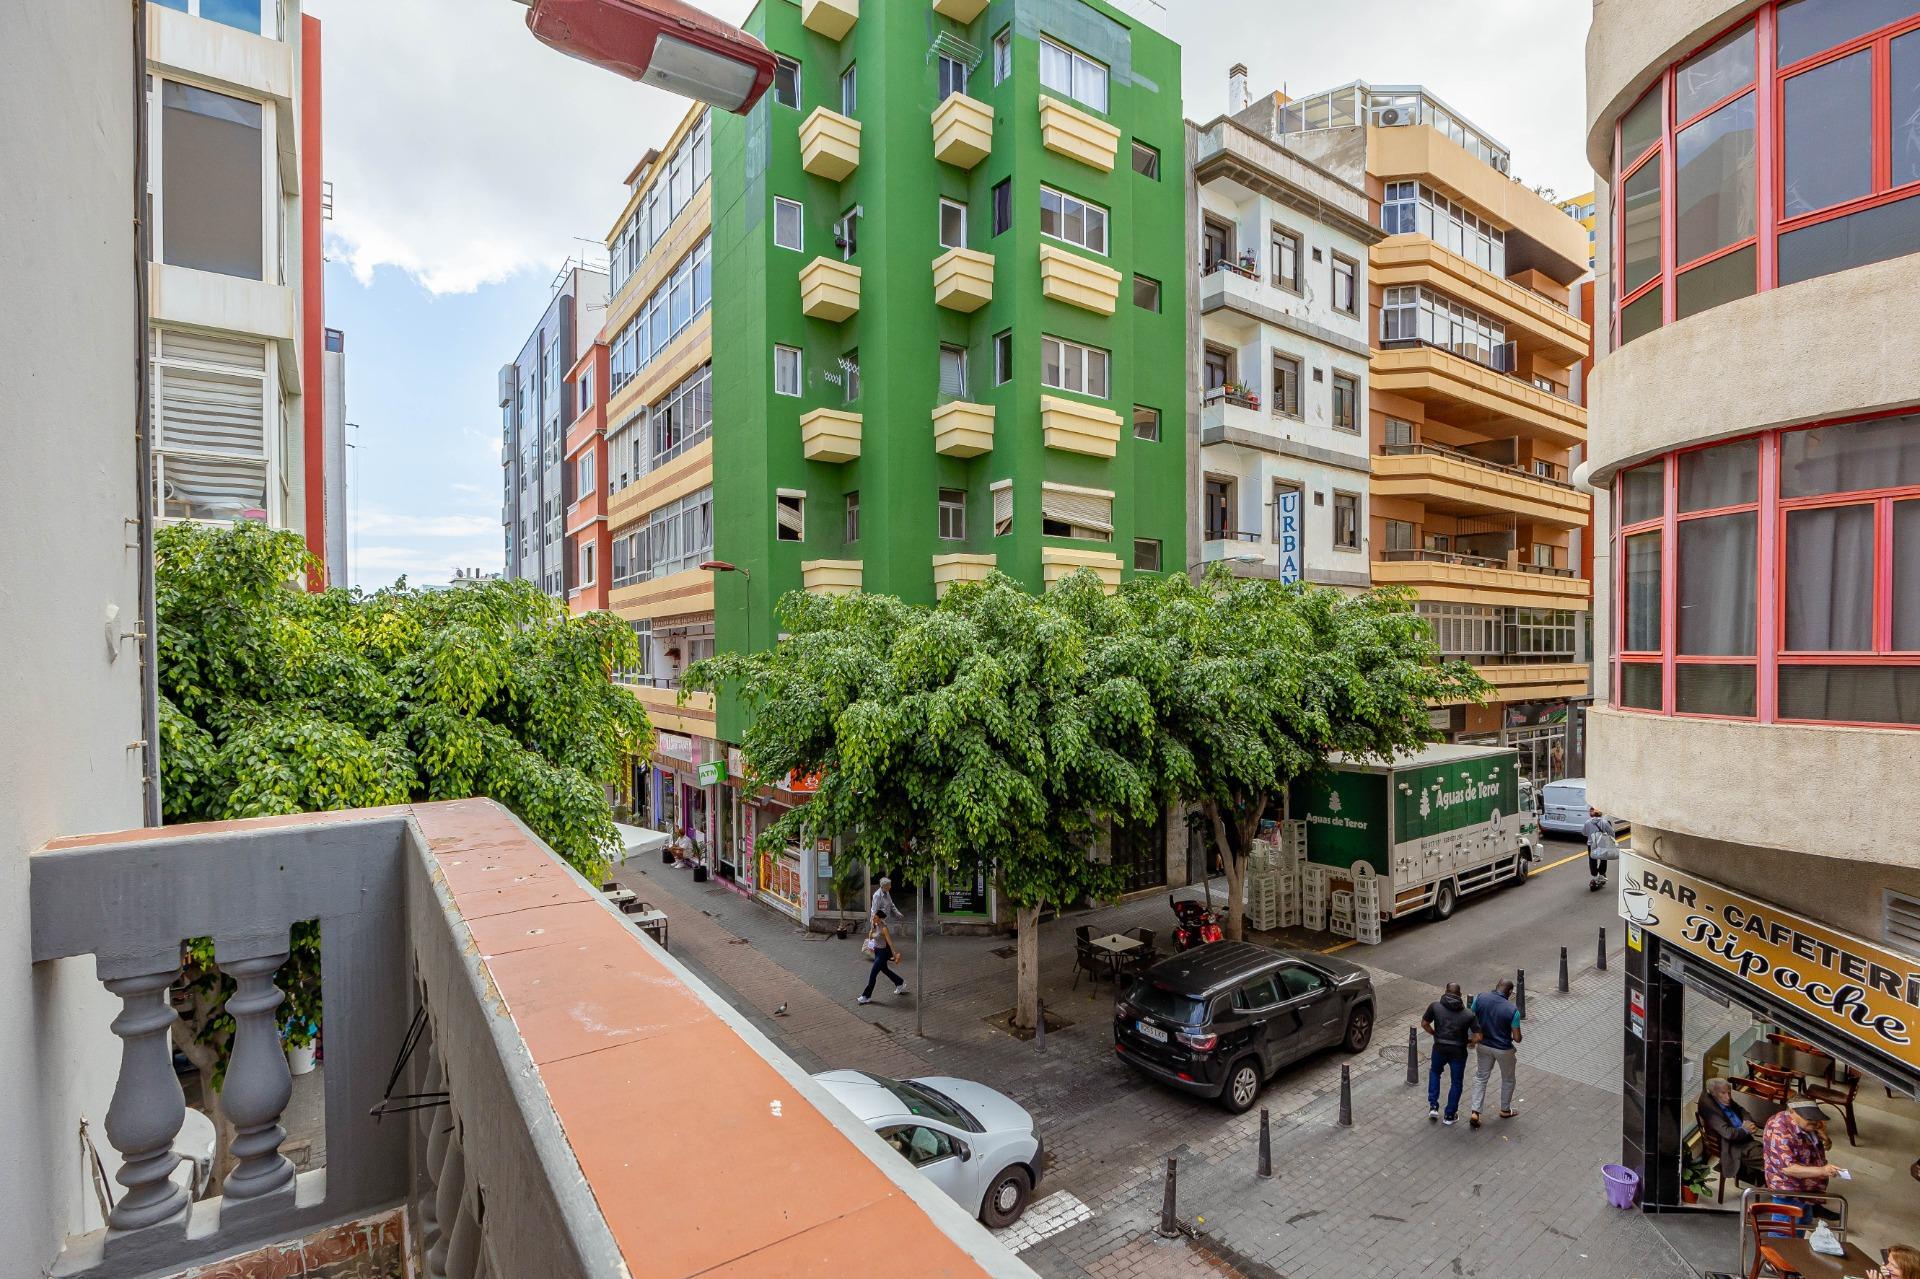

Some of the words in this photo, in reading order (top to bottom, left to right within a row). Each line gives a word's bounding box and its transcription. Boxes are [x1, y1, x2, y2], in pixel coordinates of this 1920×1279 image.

[701, 769, 717, 778] ATM
[1436, 789, 1464, 811] Aguas
[1465, 783, 1477, 801] de
[1478, 781, 1500, 799] Teror
[1306, 812, 1331, 825] Aguas
[1332, 816, 1344, 826] de
[1344, 818, 1368, 830] Teror
[1643, 870, 1697, 909] BAR
[1681, 914, 1911, 1046] Ripoche
